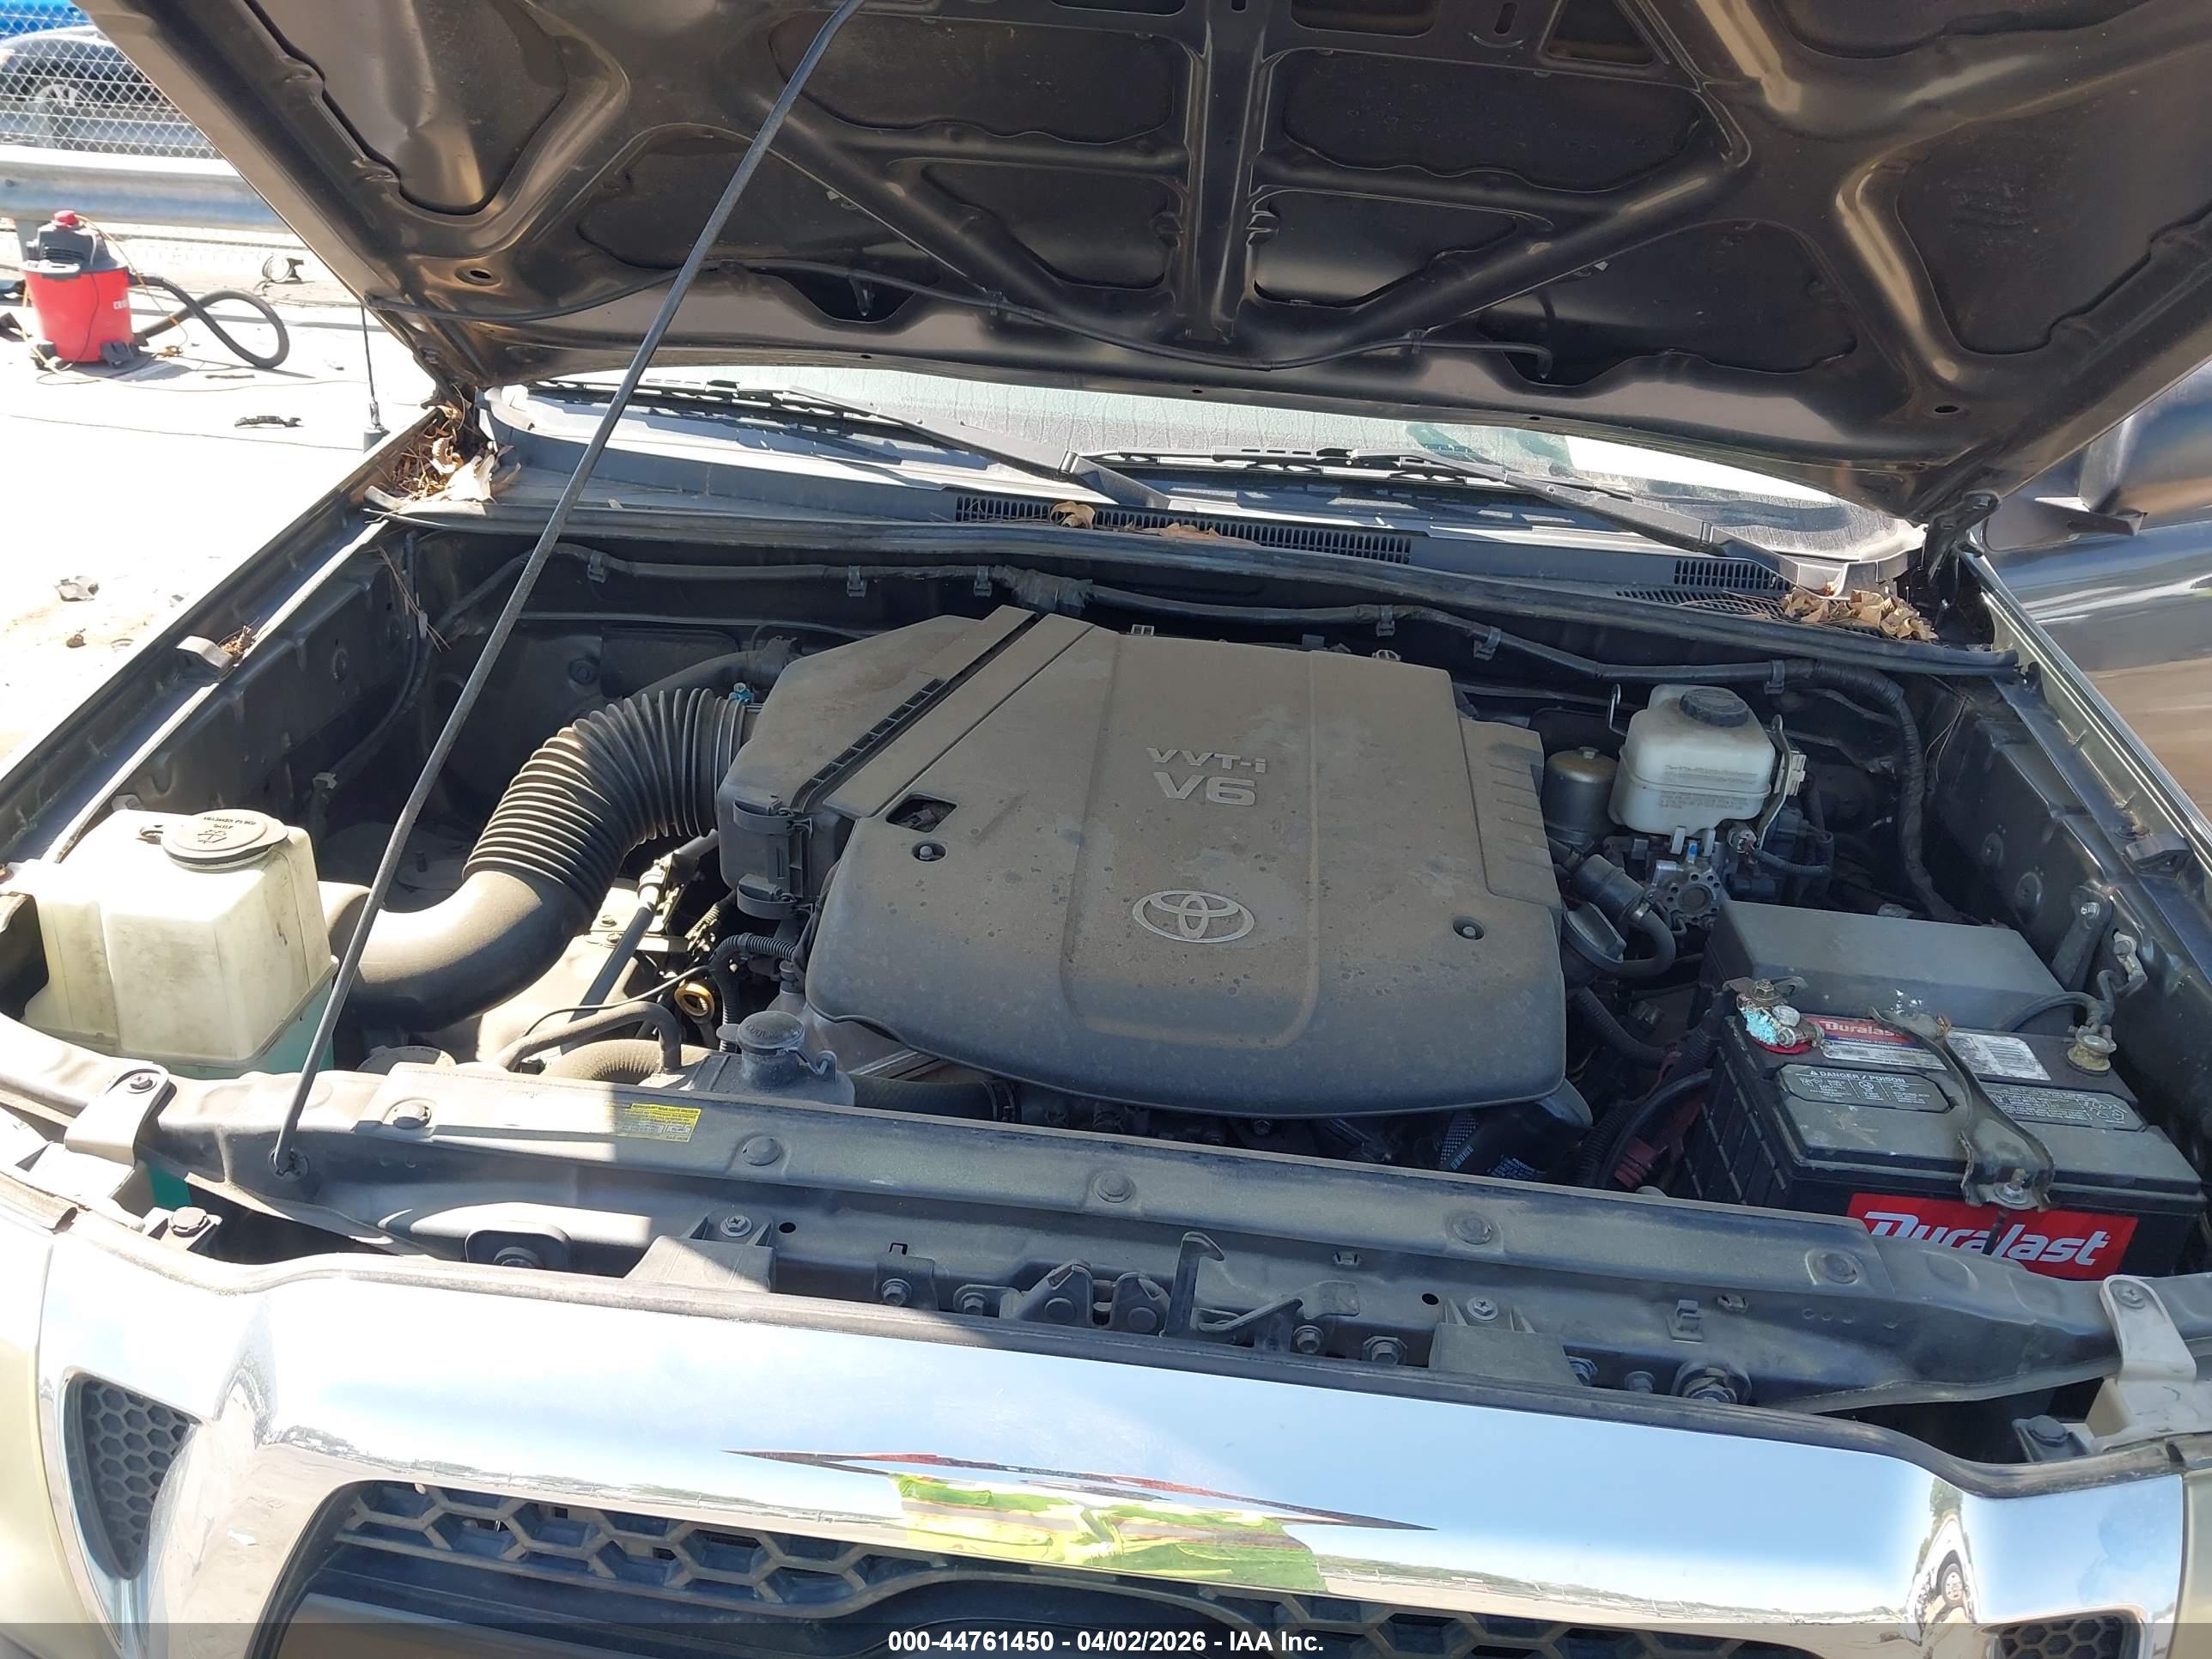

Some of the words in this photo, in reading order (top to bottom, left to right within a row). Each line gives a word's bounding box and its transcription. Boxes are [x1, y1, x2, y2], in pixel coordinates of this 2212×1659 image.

[1146, 747, 1267, 773] VVT-i
[1153, 771, 1257, 807] V6
[1819, 1071, 1860, 1080] DANGER
[1869, 1075, 1906, 1085] POISON
